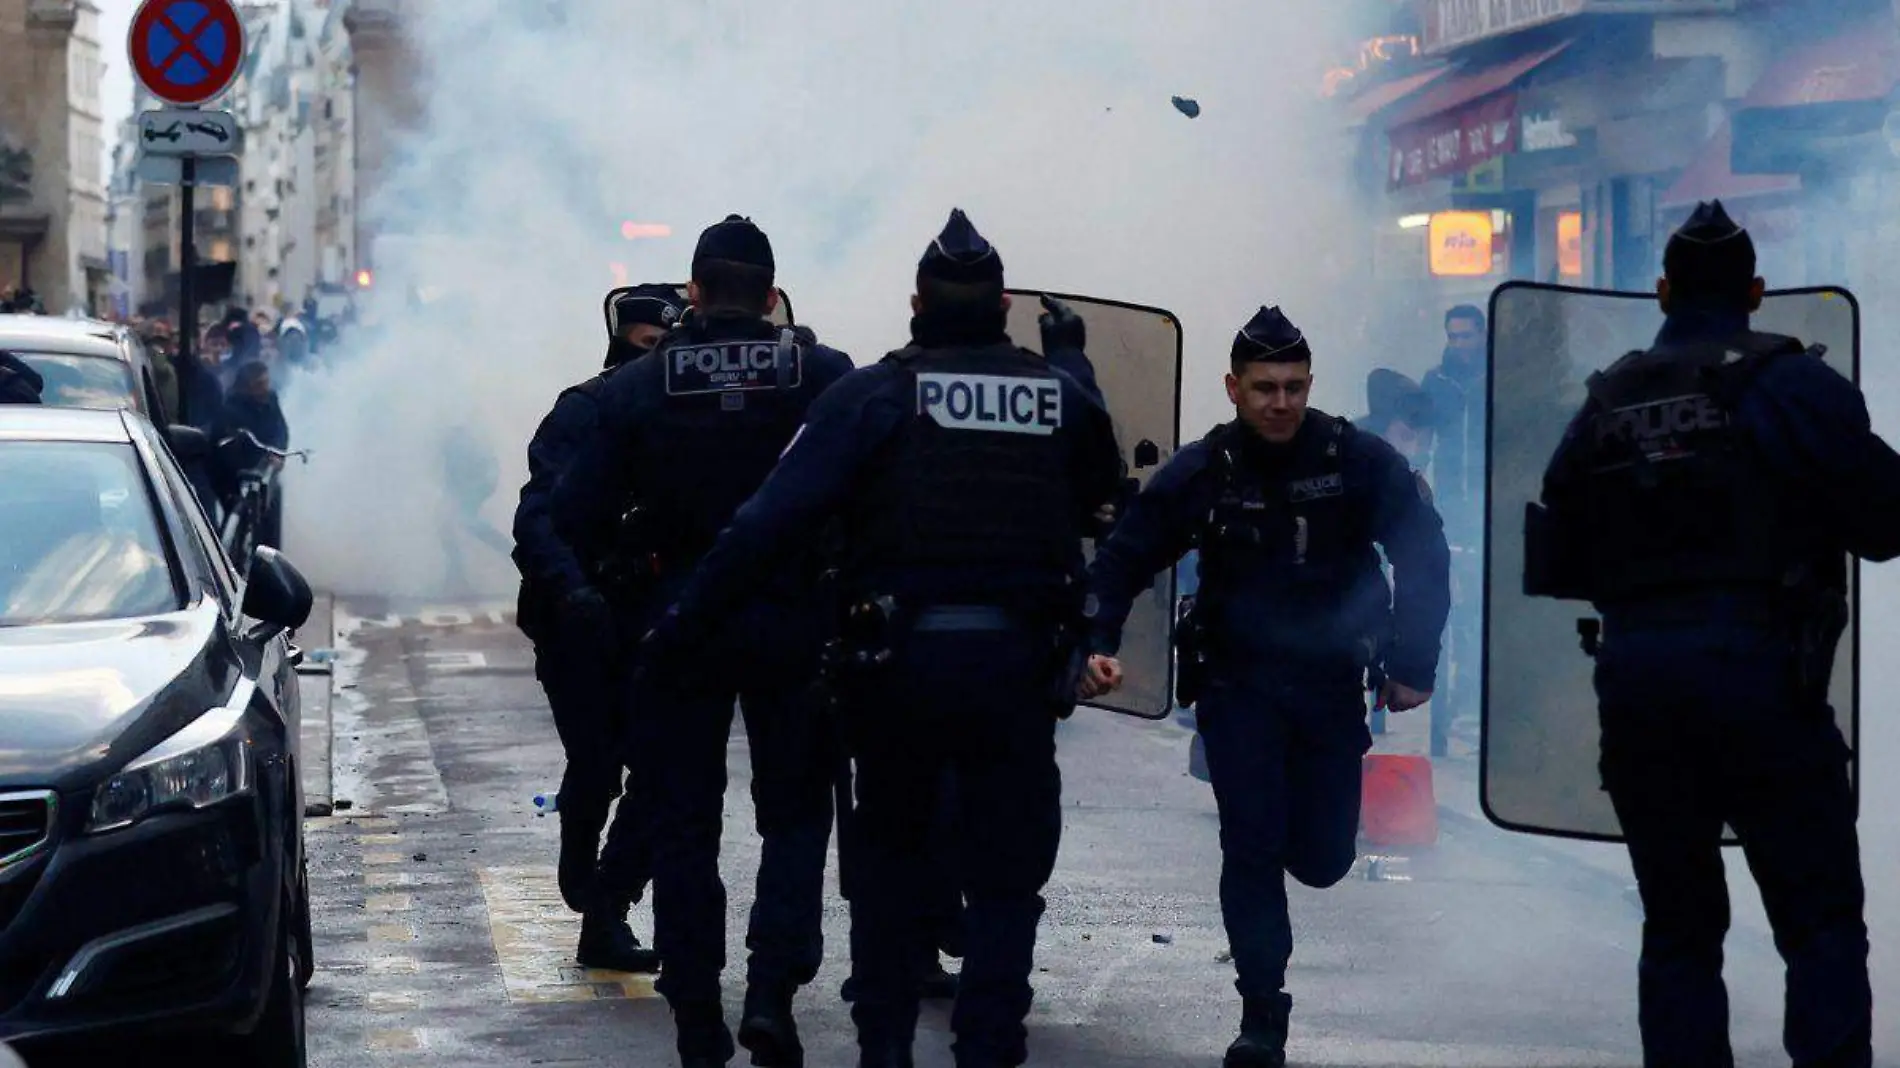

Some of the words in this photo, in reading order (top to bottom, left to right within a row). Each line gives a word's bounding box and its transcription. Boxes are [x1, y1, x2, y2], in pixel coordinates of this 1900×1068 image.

[919, 380, 1058, 427] POLICE
[1593, 398, 1722, 446] POLICE
[1292, 473, 1341, 493] POLICE
